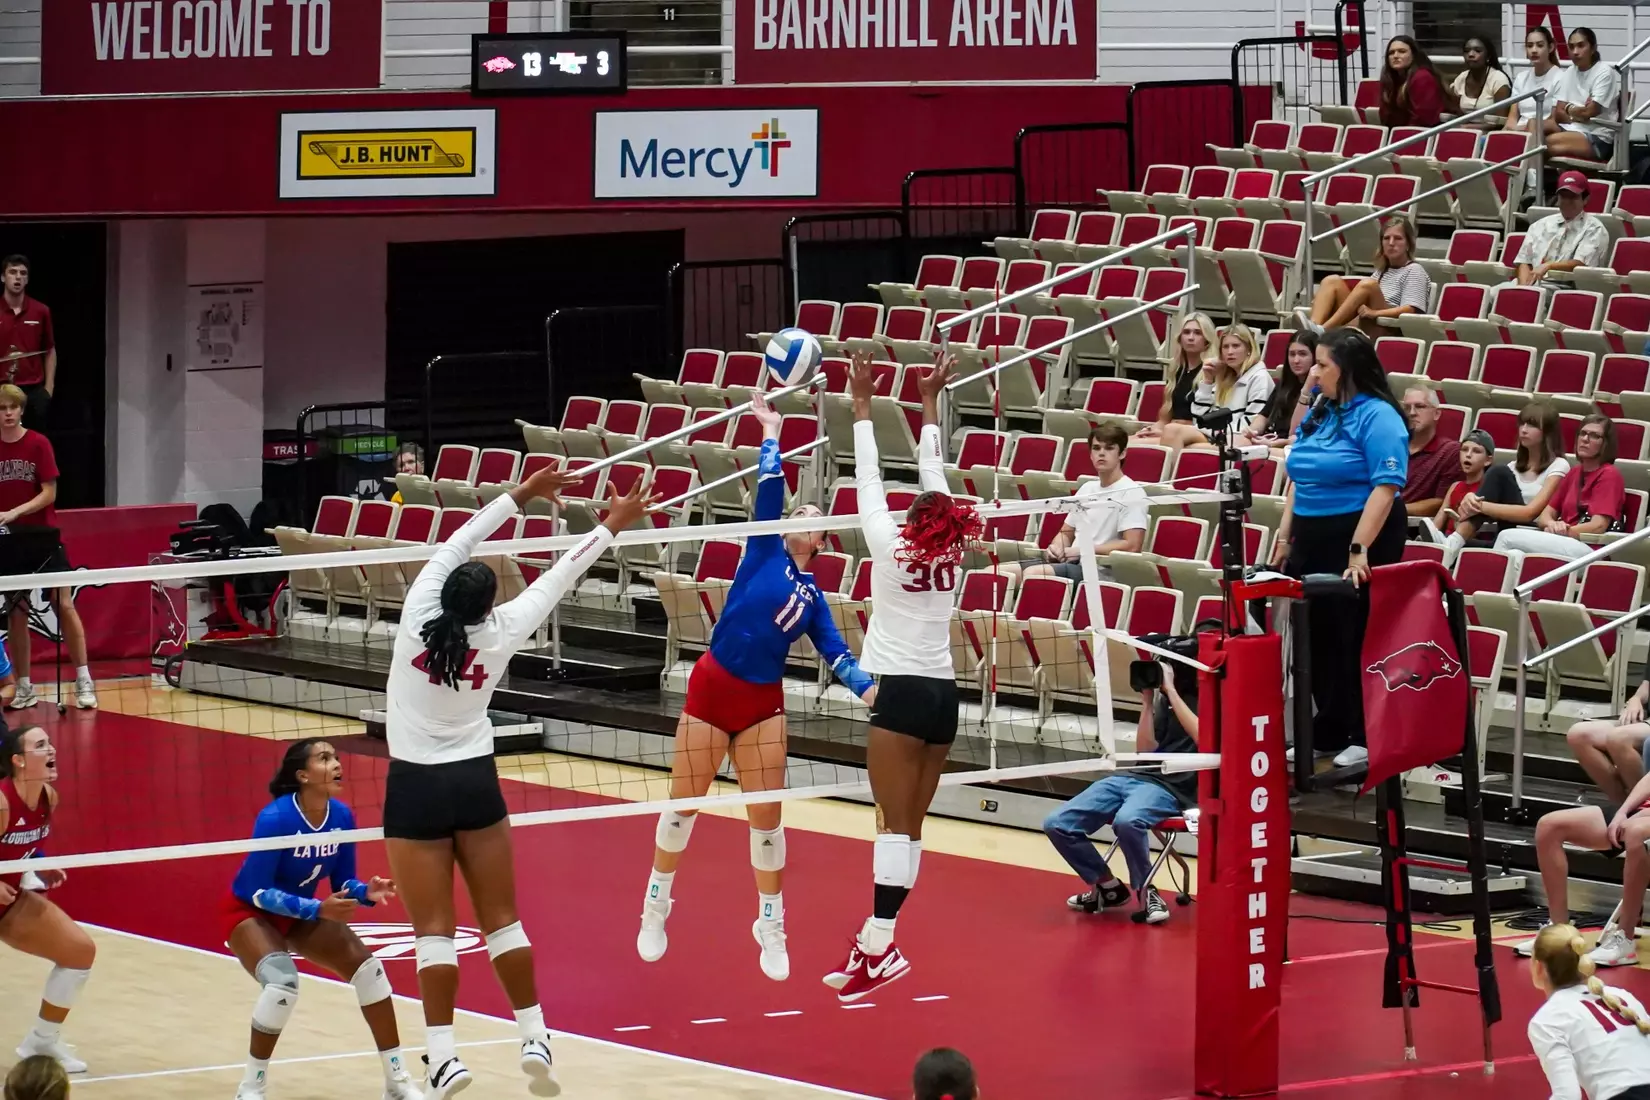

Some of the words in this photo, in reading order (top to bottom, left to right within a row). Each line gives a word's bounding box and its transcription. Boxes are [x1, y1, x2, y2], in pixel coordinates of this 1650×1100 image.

[663, 8, 675, 21] 11
[754, 0, 938, 50] BARNHILL
[948, 0, 1077, 47] ARENA
[91, 0, 274, 60] WELCOME
[286, 0, 331, 56] TO
[522, 52, 542, 76] 13
[597, 51, 610, 75] 3
[380, 145, 432, 162] HUNT
[620, 138, 753, 188] Mercy
[273, 443, 307, 456] TRAS
[901, 561, 956, 593] 30
[796, 581, 814, 605] TEC
[774, 592, 806, 633] 11
[293, 845, 311, 858] LA
[1248, 715, 1270, 990] TOGETHER
[298, 864, 322, 887] 1
